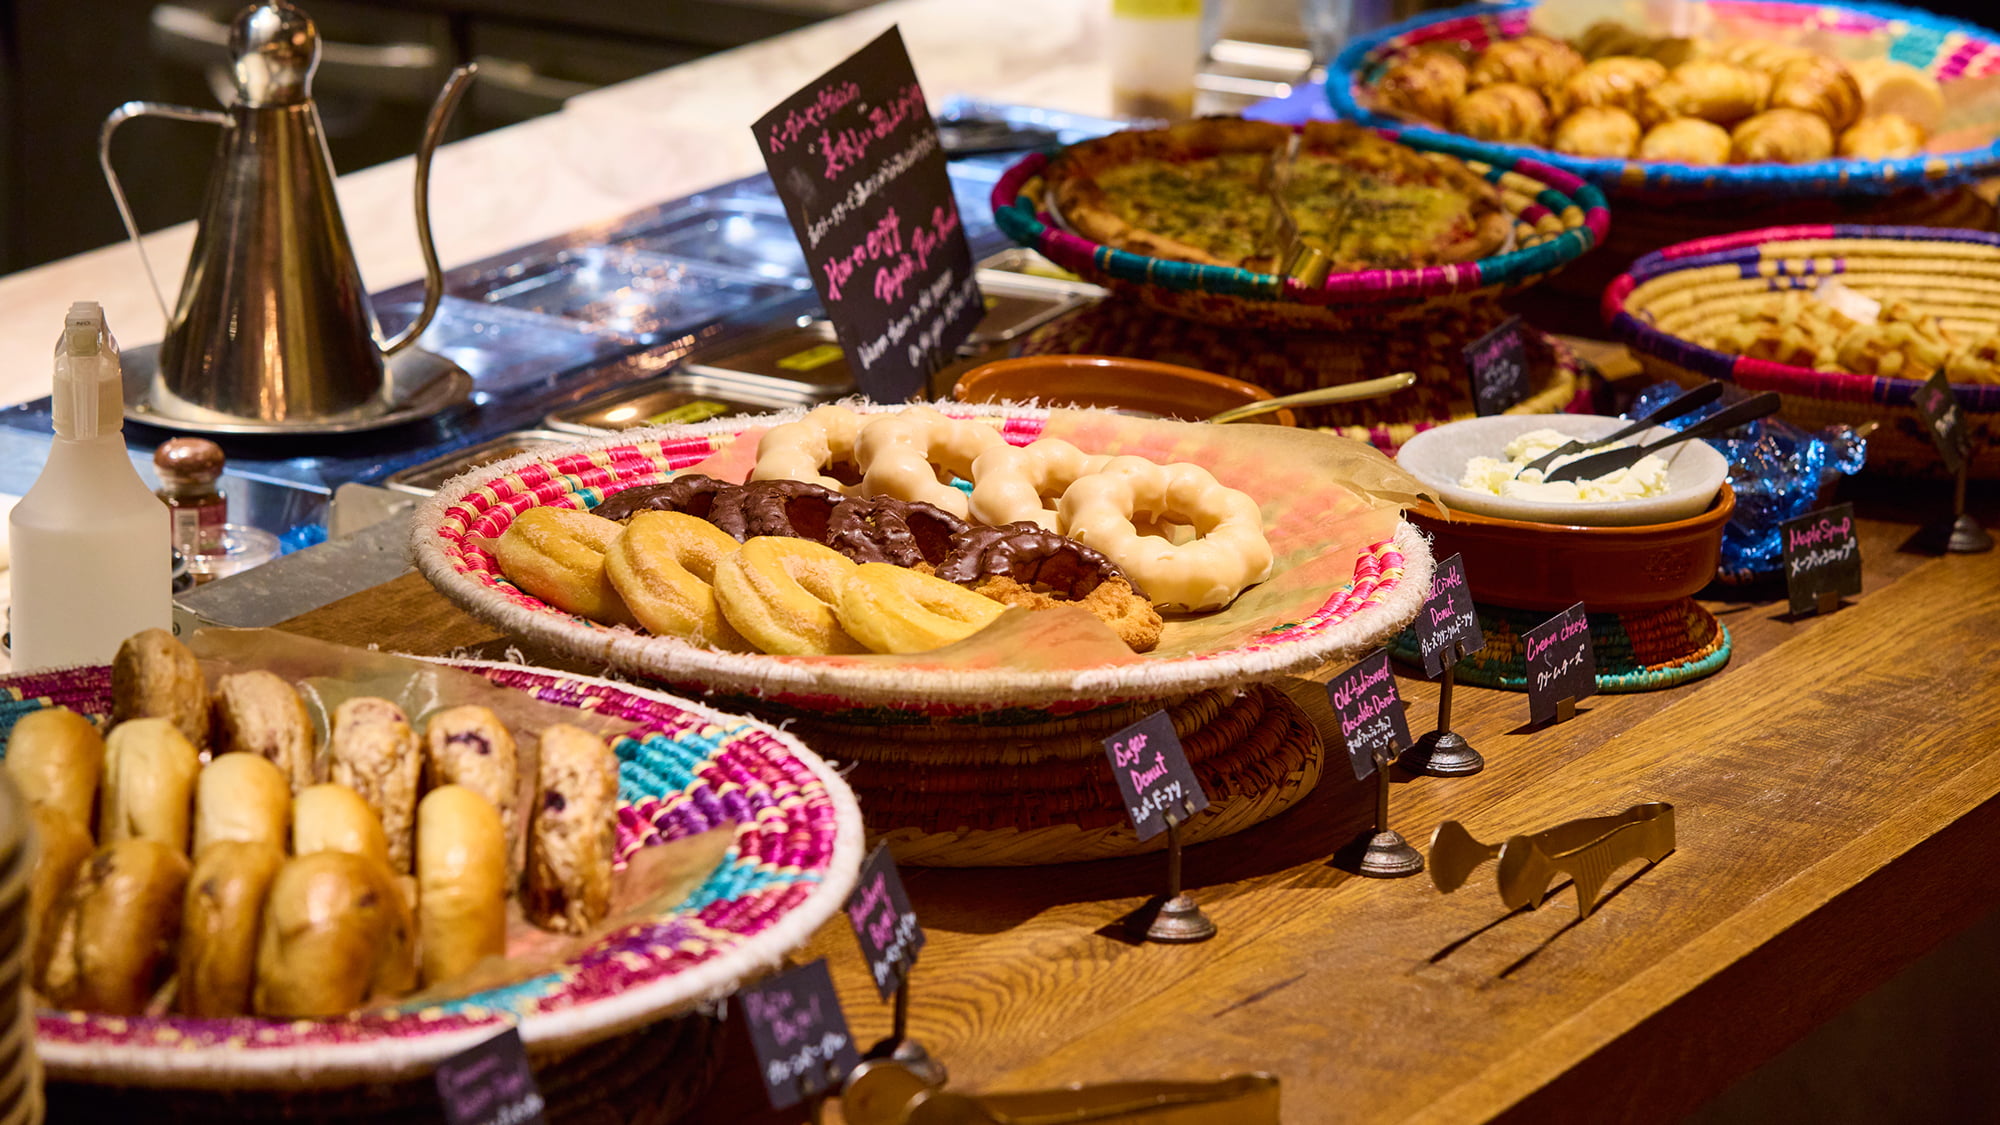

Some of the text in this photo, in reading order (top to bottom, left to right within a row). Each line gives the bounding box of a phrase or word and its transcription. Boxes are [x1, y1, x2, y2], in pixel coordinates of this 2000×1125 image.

[1430, 593, 1455, 627] Donut
[1527, 632, 1558, 662] Cream
[1371, 685, 1396, 714] Donut
[1113, 732, 1148, 768] Sugar
[1129, 751, 1168, 795] Donut
